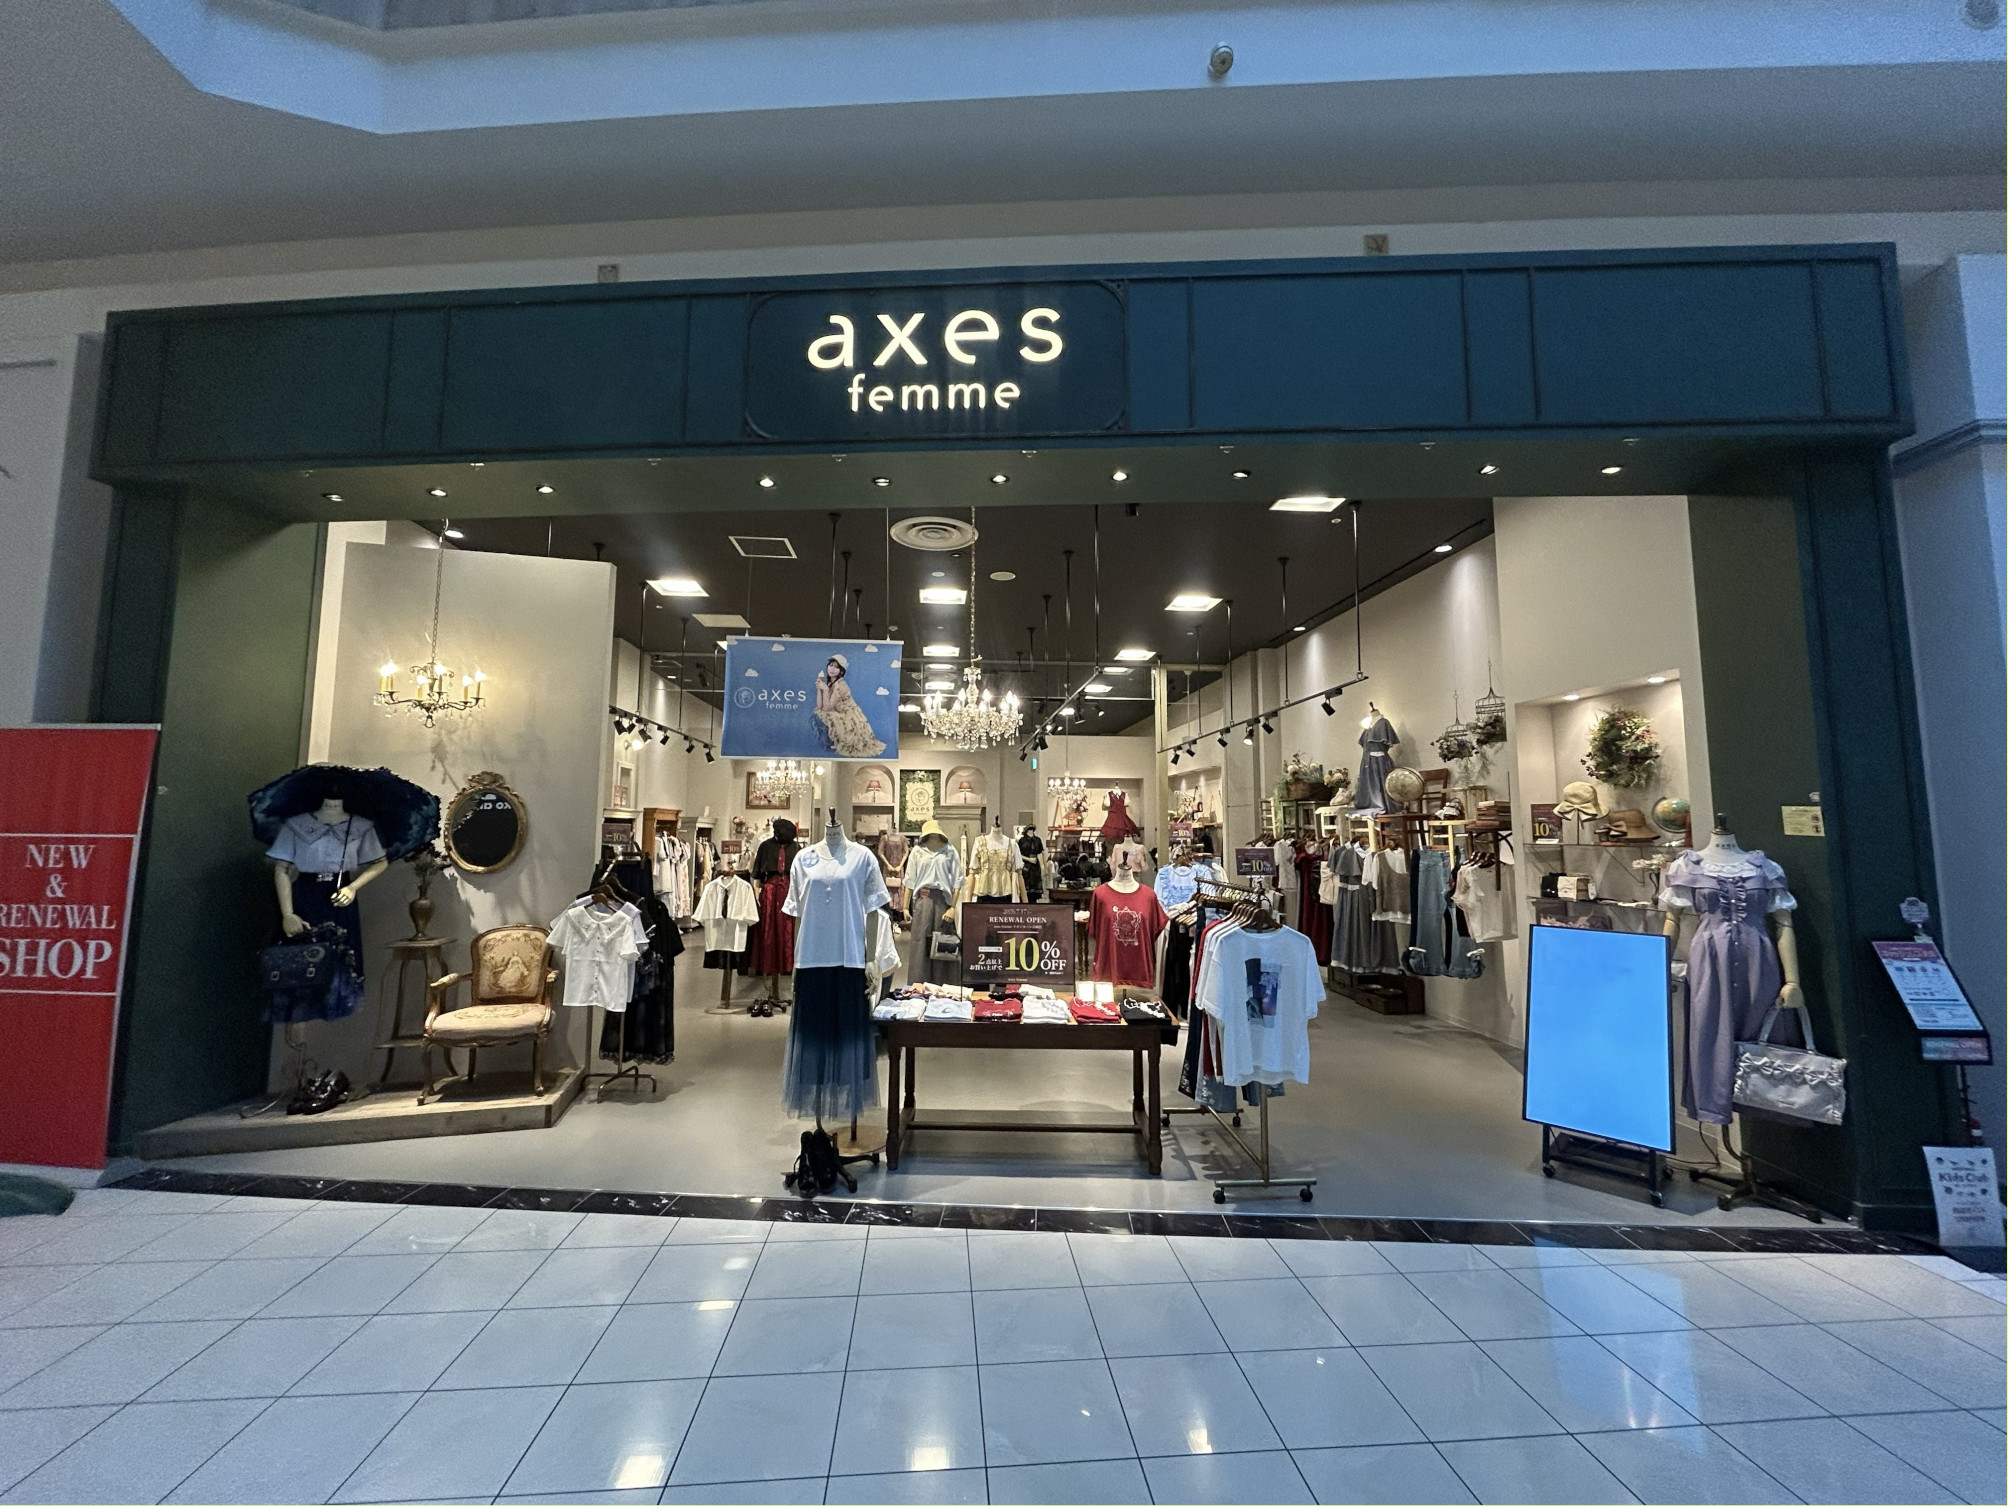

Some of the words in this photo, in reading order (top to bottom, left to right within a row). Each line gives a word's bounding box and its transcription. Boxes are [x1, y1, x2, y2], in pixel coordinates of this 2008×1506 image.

[807, 306, 1064, 370] axes
[847, 372, 1022, 413] femme
[758, 688, 807, 702] axes
[765, 701, 799, 710] femme
[25, 844, 96, 869] NEW
[46, 873, 68, 898] &
[989, 916, 1024, 924] RENEWAL
[1026, 916, 1047, 924] OPEN
[1040, 959, 1067, 971] OFF
